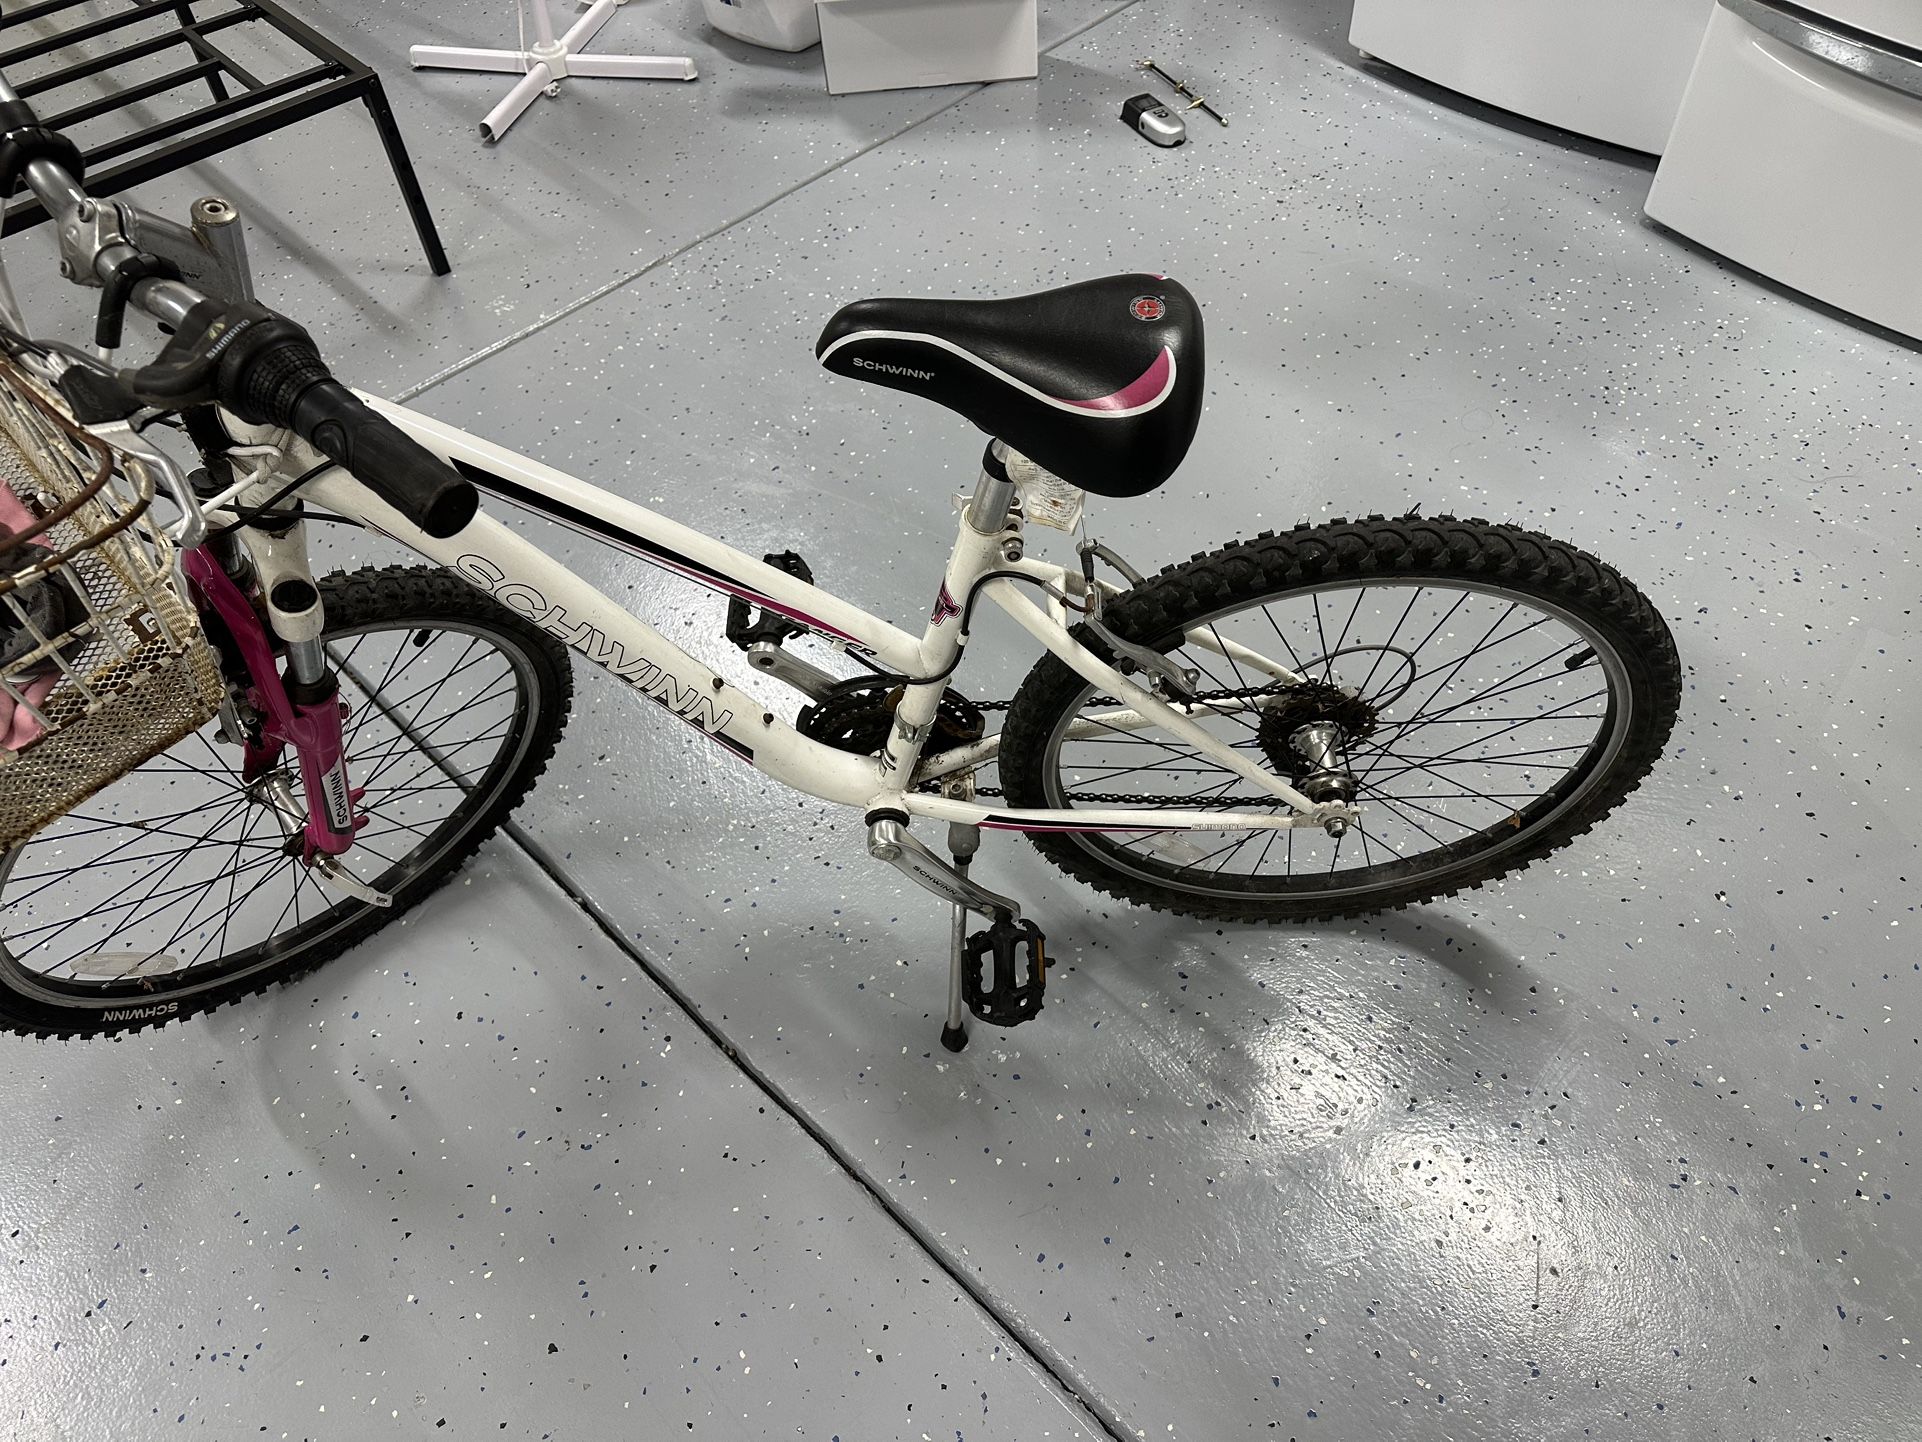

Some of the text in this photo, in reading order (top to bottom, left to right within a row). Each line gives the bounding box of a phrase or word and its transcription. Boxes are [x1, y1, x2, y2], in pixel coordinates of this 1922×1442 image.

[205, 319, 251, 360] SHIMANO
[853, 357, 931, 381] SCHWINN
[456, 554, 734, 735] SCHWINN
[329, 769, 348, 825] SCHWINN
[912, 865, 958, 896] SCHWINN
[102, 1002, 179, 1022] SCHWINN
